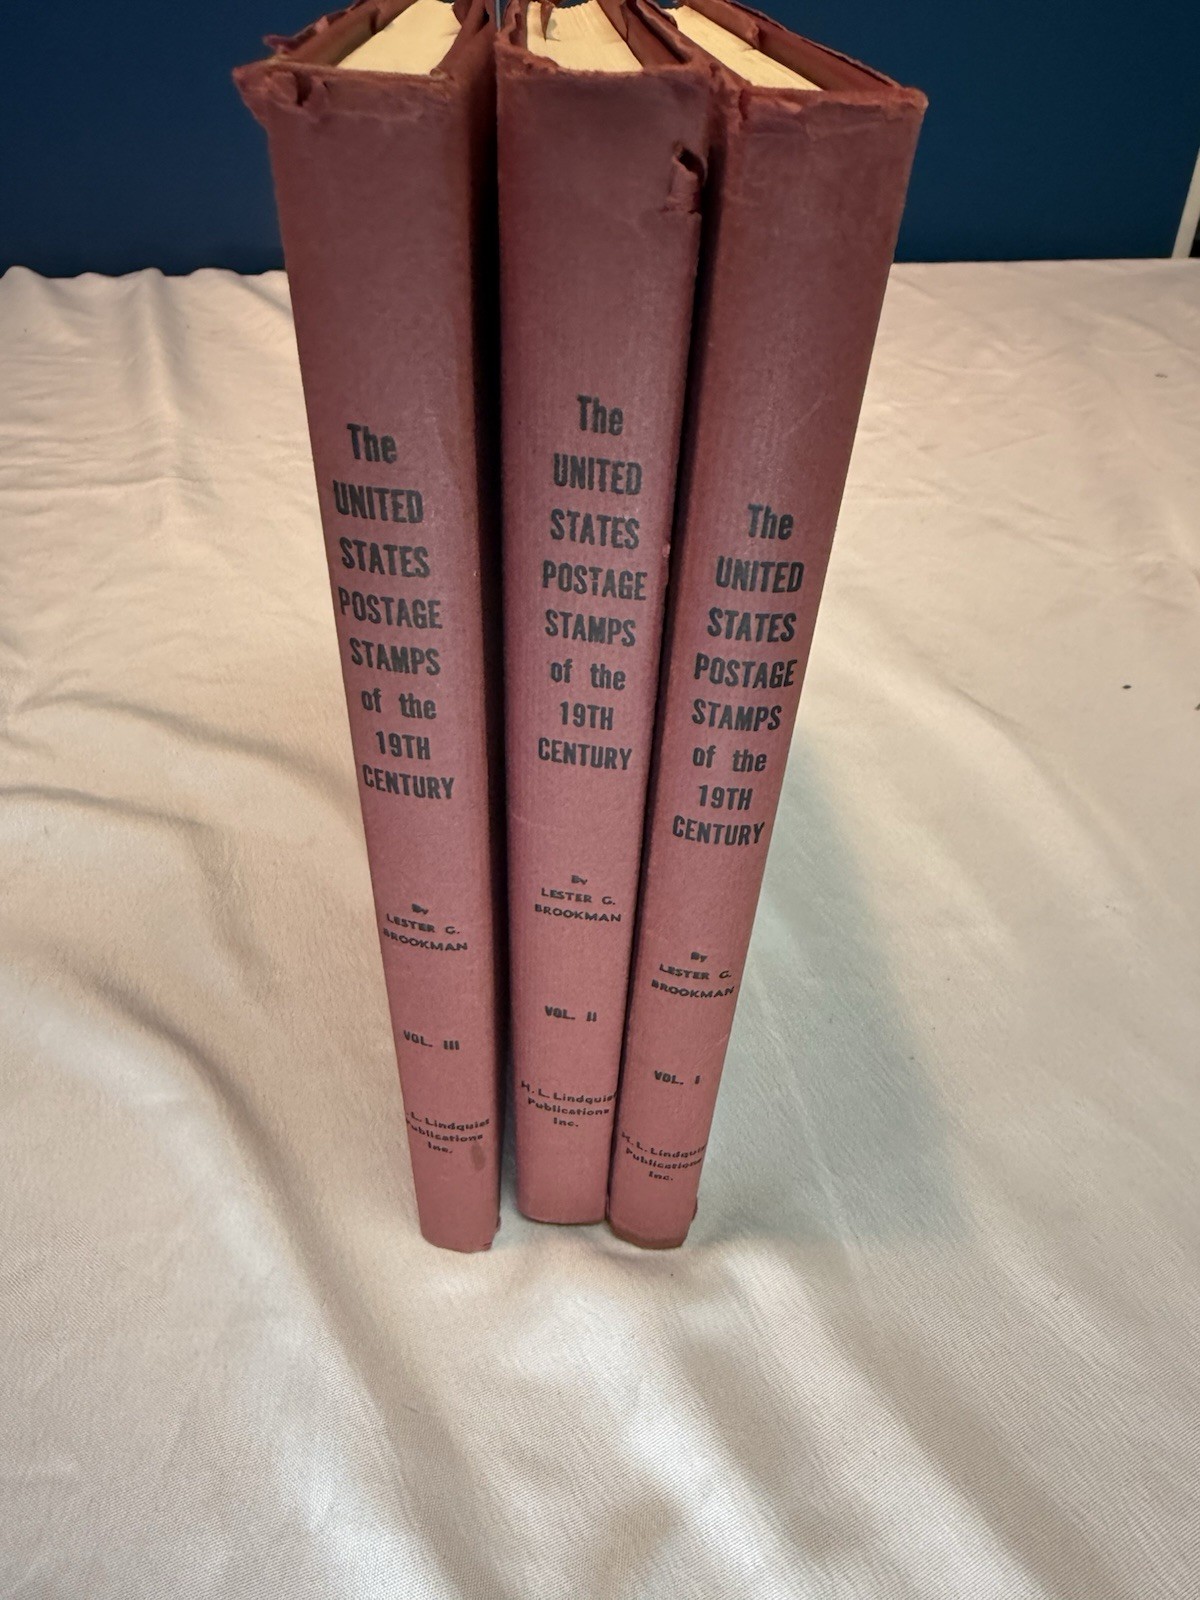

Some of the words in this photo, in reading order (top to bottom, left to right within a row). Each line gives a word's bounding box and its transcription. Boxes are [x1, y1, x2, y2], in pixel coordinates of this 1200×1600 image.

[577, 394, 623, 436] The
[347, 423, 396, 464] The
[552, 452, 642, 495] UNITED
[332, 480, 423, 523] UNITED
[549, 508, 639, 549] STATES
[748, 504, 794, 540] The
[338, 536, 429, 577] STATES
[541, 559, 647, 600] POSTAGE
[716, 556, 804, 593] UNITED
[338, 586, 444, 630] POSTAGE
[545, 609, 635, 647] STAMPS
[707, 607, 797, 643] STATES
[348, 637, 440, 675] STAMPS
[694, 653, 798, 689] POSTAGE
[550, 659, 572, 683] of
[590, 663, 626, 690] the
[361, 688, 381, 713] of
[398, 693, 436, 719] the
[560, 701, 613, 730] 19TH
[692, 699, 782, 731] STAMPS
[376, 731, 430, 760] 19TH
[538, 737, 632, 770] CENTURY
[693, 745, 716, 768] of
[733, 749, 767, 772] the
[362, 764, 454, 799] CENTURY
[699, 785, 753, 810] 19TH
[673, 815, 765, 846] CENTURY
[541, 888, 593, 904] LESTER
[386, 913, 435, 933] LESTER
[534, 904, 622, 922] BROOKMAN
[382, 928, 469, 951] BROOKMAN
[659, 963, 710, 980] LESTER
[651, 979, 735, 998] BROOKMAN
[544, 1005, 576, 1020] VOL.
[586, 1011, 598, 1022] II
[403, 1029, 433, 1048] VOL.
[443, 1040, 461, 1051] III
[653, 1070, 684, 1085] VOL.
[528, 1097, 610, 1116] Publications
[553, 1117, 579, 1127] Inc.
[427, 1141, 453, 1154] Inc.
[650, 1143, 707, 1158] Lindqui
[649, 1171, 673, 1181] Inc.
